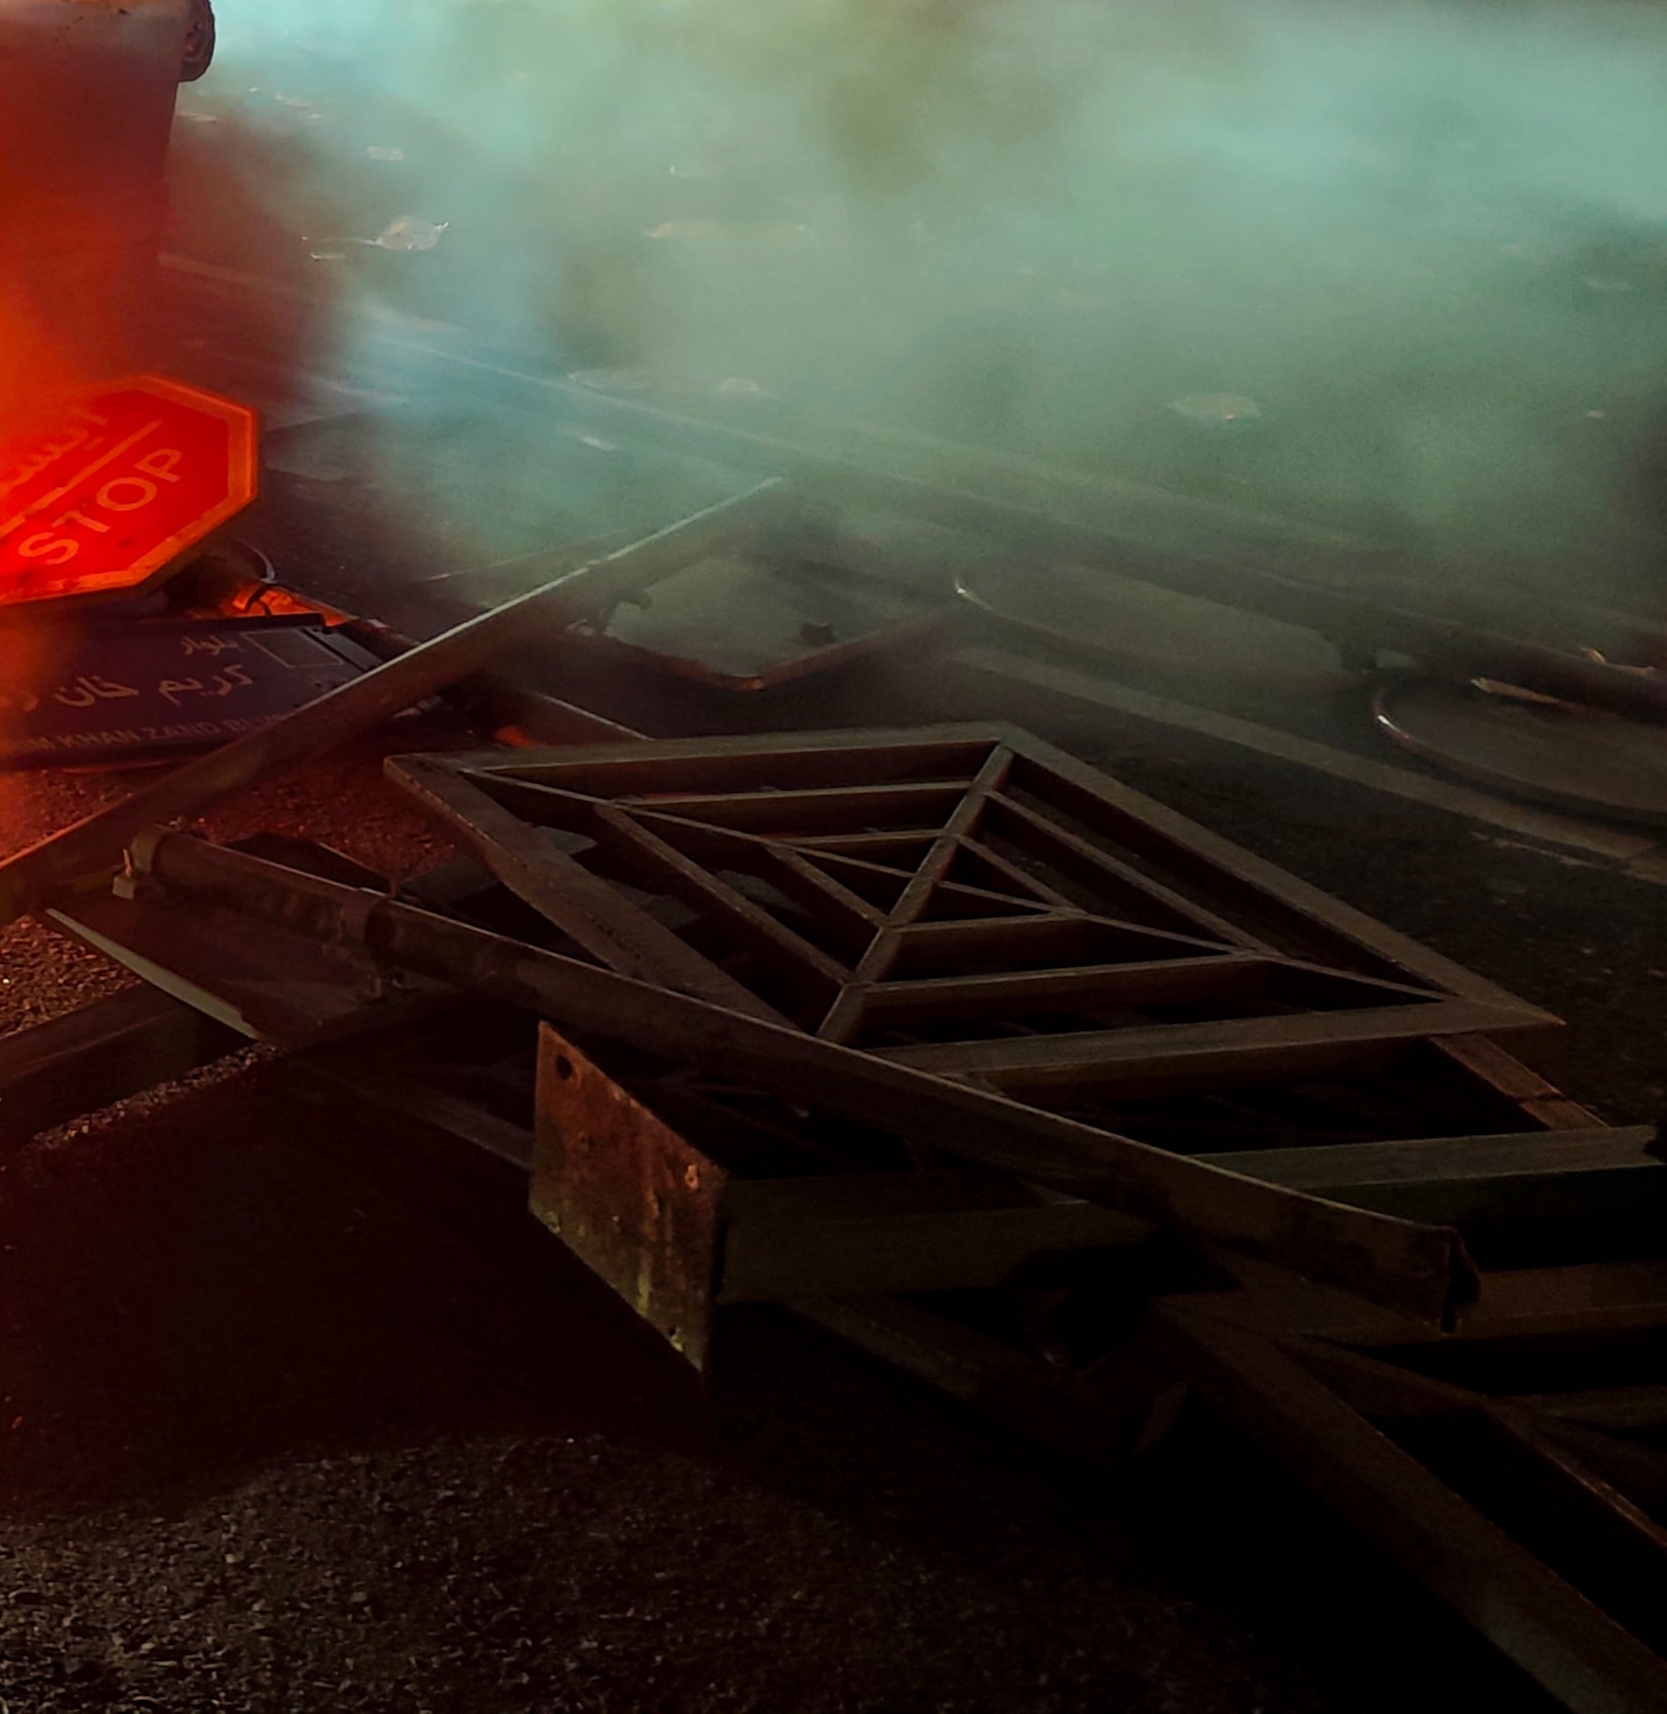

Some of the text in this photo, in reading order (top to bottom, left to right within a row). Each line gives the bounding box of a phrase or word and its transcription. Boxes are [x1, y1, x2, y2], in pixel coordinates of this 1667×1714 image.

[17, 447, 184, 566] STOP
[51, 674, 140, 708] خان
[157, 664, 255, 707] کریم
[56, 728, 142, 750] KHAN
[141, 721, 221, 741] ZAND
